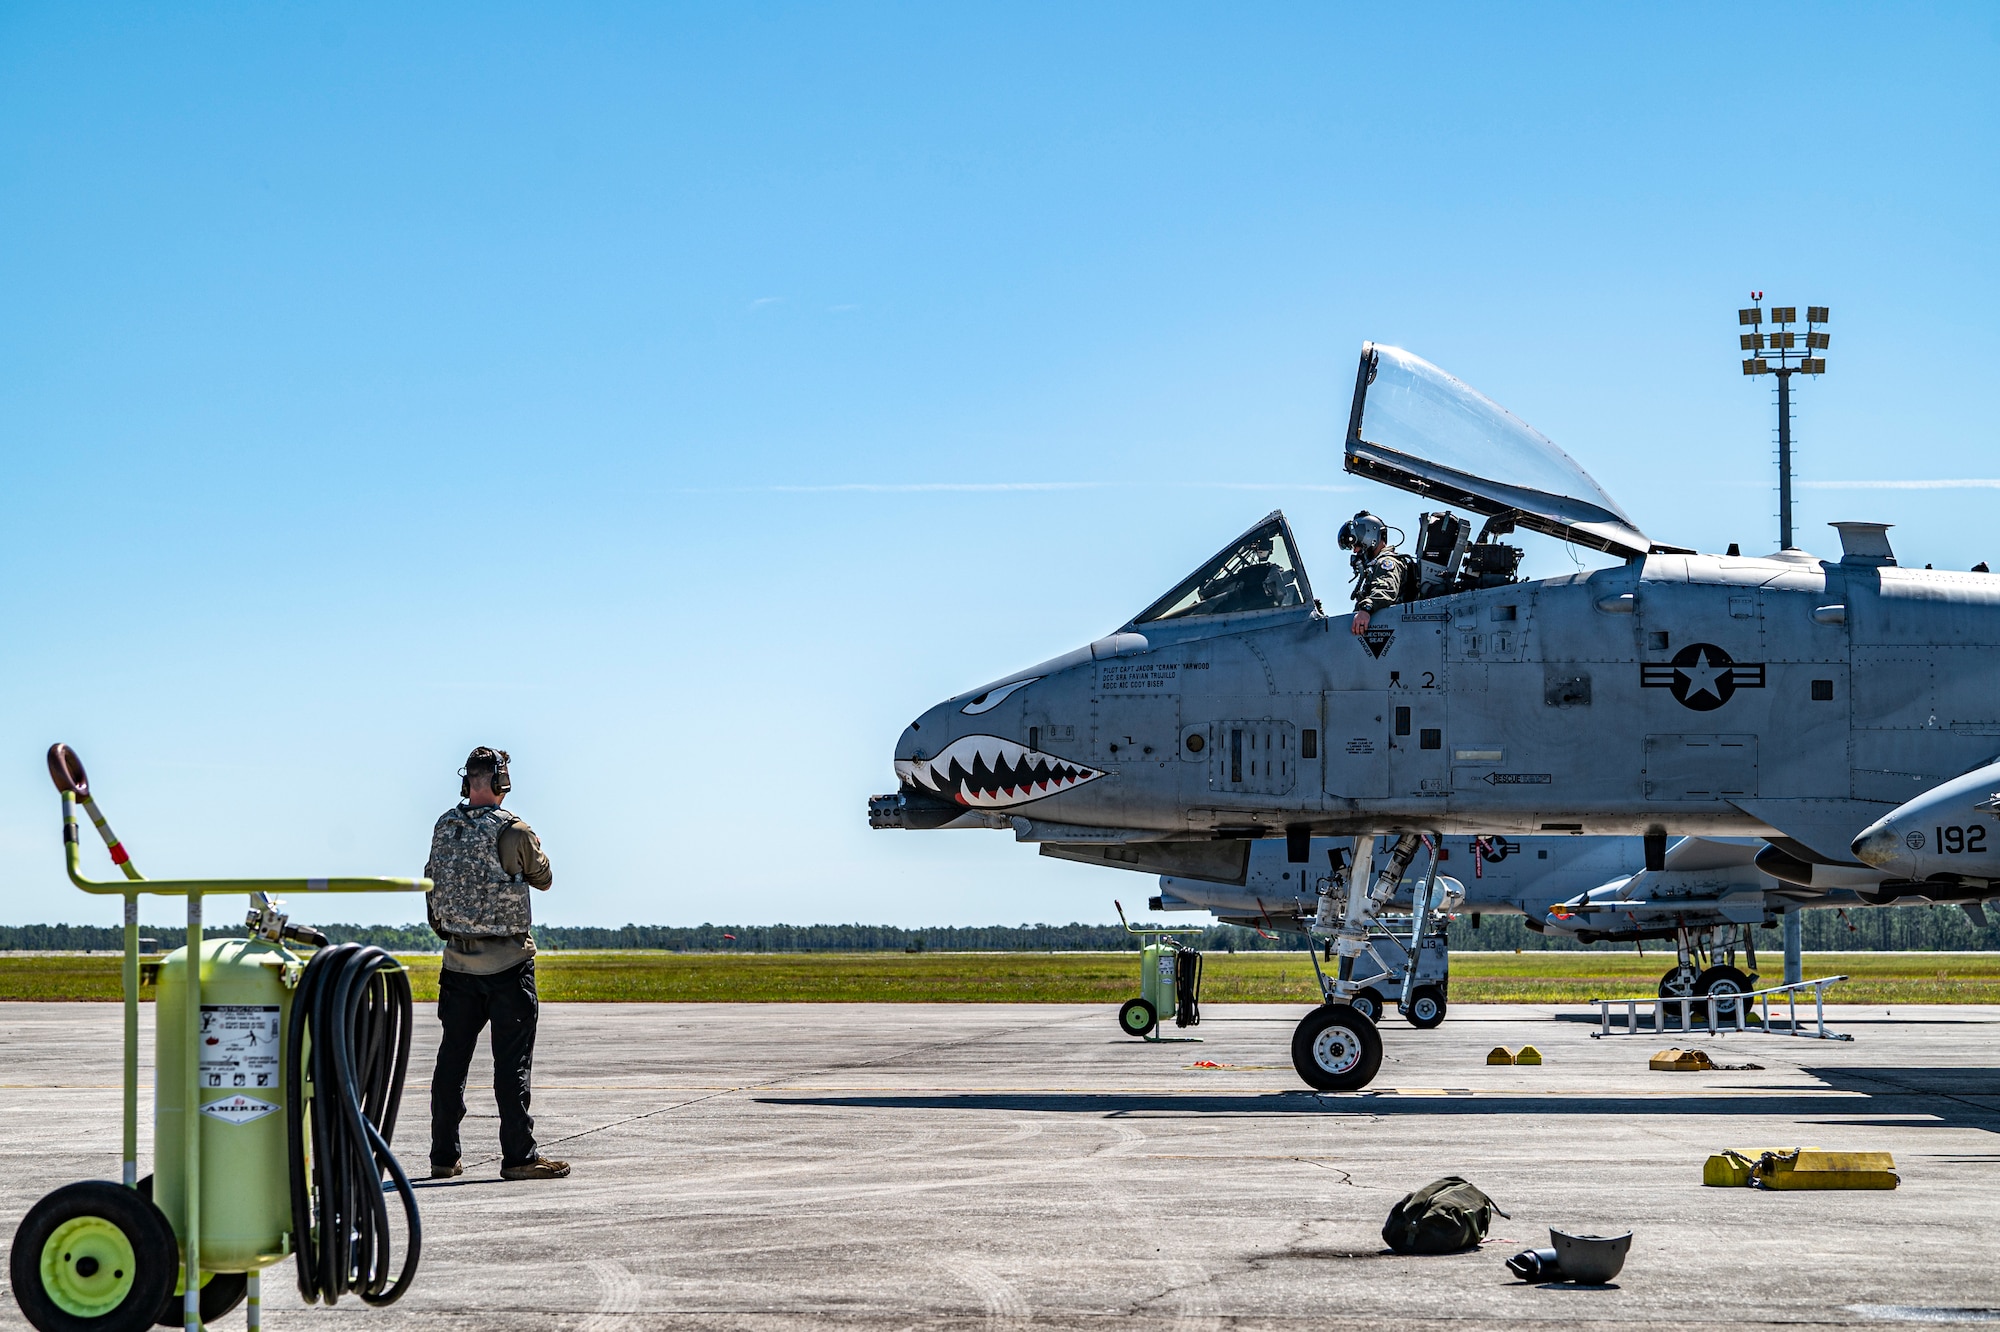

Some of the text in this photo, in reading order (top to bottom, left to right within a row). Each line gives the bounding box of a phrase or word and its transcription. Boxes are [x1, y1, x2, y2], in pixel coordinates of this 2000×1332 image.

[1357, 636, 1373, 658] DANGER
[1381, 635, 1397, 657] DANGER
[1103, 662, 1210, 674] PILOT CAPT JACOB "CRANK" YARWOOD
[1115, 673, 1127, 681] SRA
[1128, 672, 1149, 680] FAVIAN
[1150, 671, 1176, 679] TRUJILLO
[1421, 671, 1435, 689] 2
[1130, 680, 1145, 688] CODY
[1147, 680, 1164, 688] BISER
[1494, 774, 1521, 783] RESCUE
[1935, 824, 1988, 855] 192
